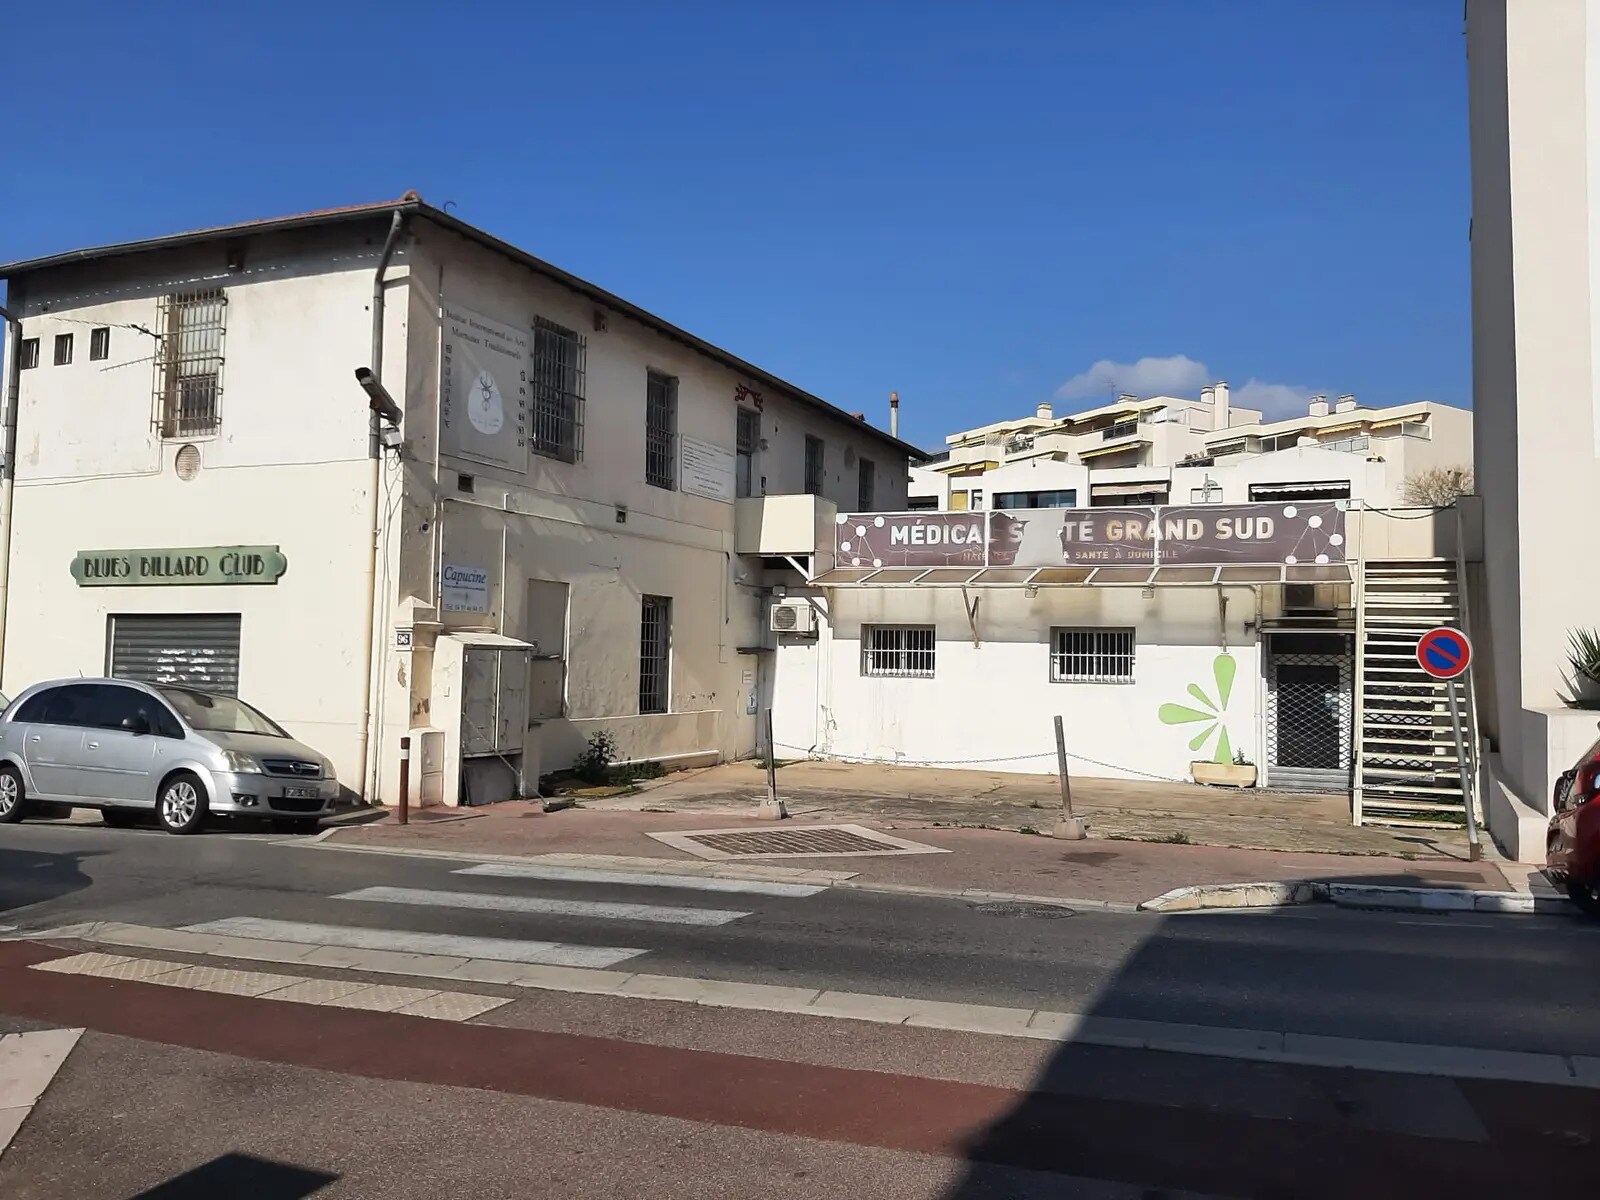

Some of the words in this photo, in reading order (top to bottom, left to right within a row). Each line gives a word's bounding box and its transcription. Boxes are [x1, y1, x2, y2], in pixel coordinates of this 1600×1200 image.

[1008, 515, 1095, 543] STÉ
[1105, 518, 1204, 541] GRAND
[1214, 517, 1275, 540] SUD
[1075, 548, 1109, 559] SANTÉ
[84, 557, 131, 577] BLUES
[140, 555, 209, 577] BILLARD
[219, 553, 265, 576] CLUB
[444, 566, 486, 584] Capucine
[398, 634, 409, 644] 96
